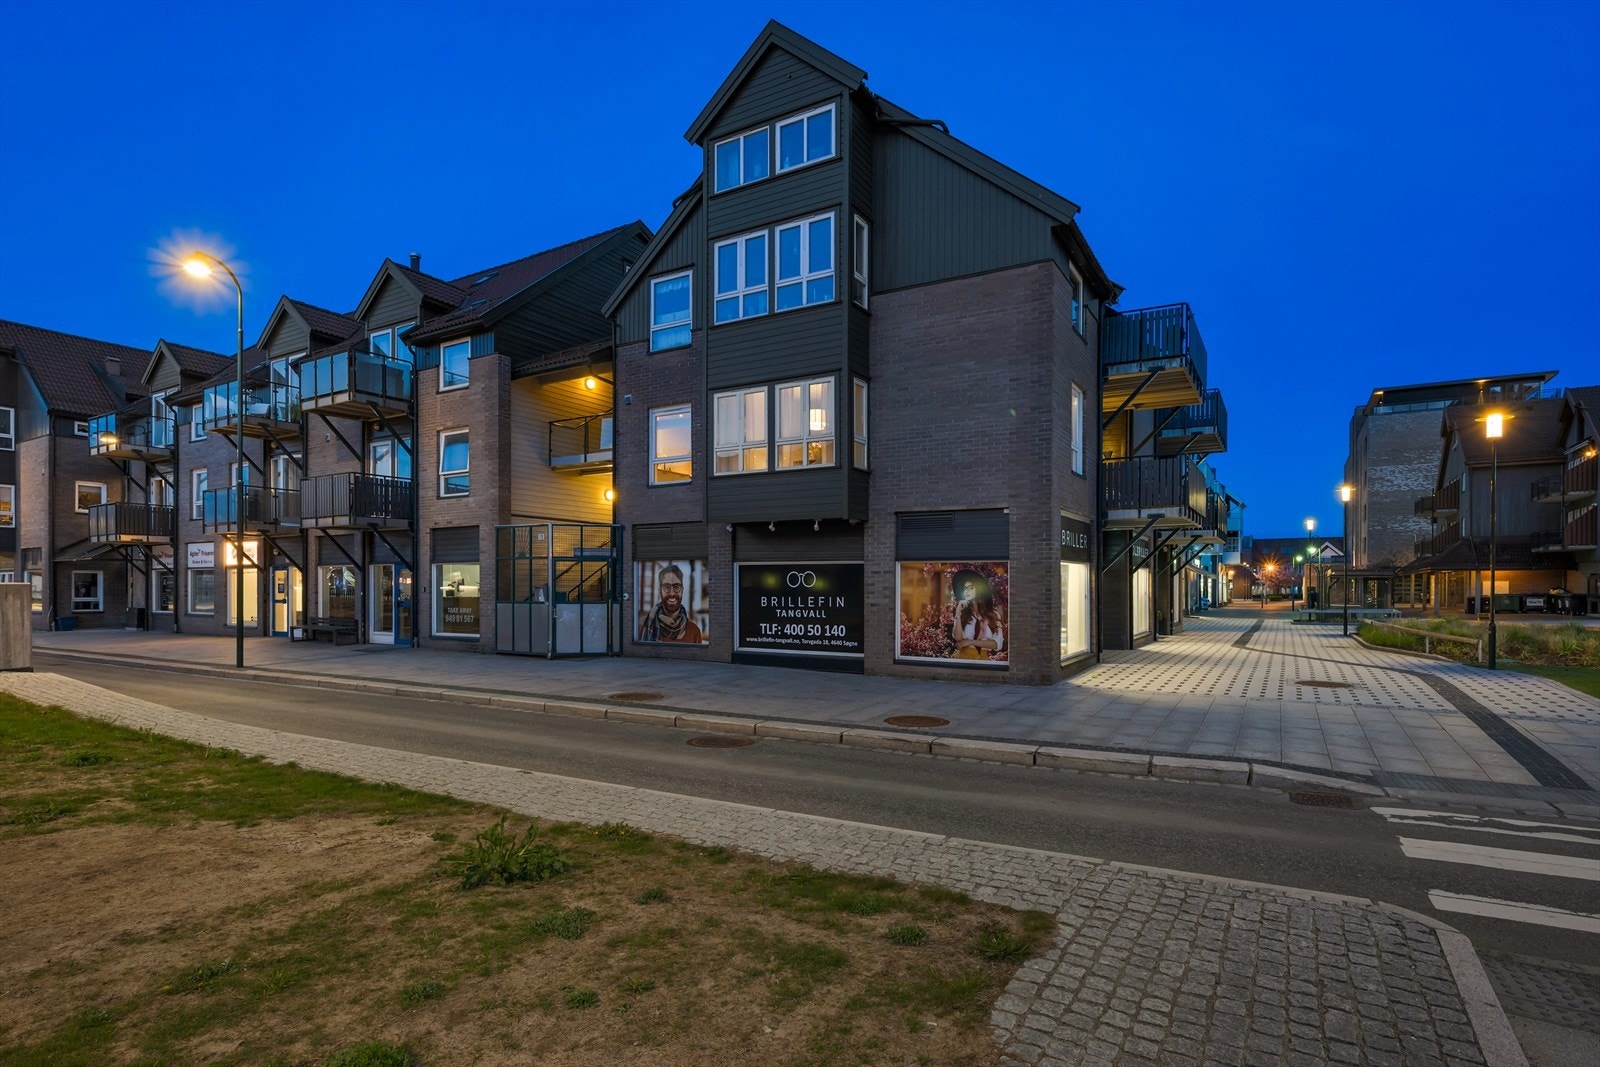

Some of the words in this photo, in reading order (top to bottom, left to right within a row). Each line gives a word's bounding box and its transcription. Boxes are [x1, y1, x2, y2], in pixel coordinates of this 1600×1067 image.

[1061, 529, 1088, 549] BRILLER
[760, 596, 845, 608] BRILLEFIN
[776, 609, 826, 618] TANGVALL
[760, 623, 781, 635] TLF:
[784, 624, 804, 635] 400
[807, 624, 822, 636] 50
[824, 625, 846, 637] 140
